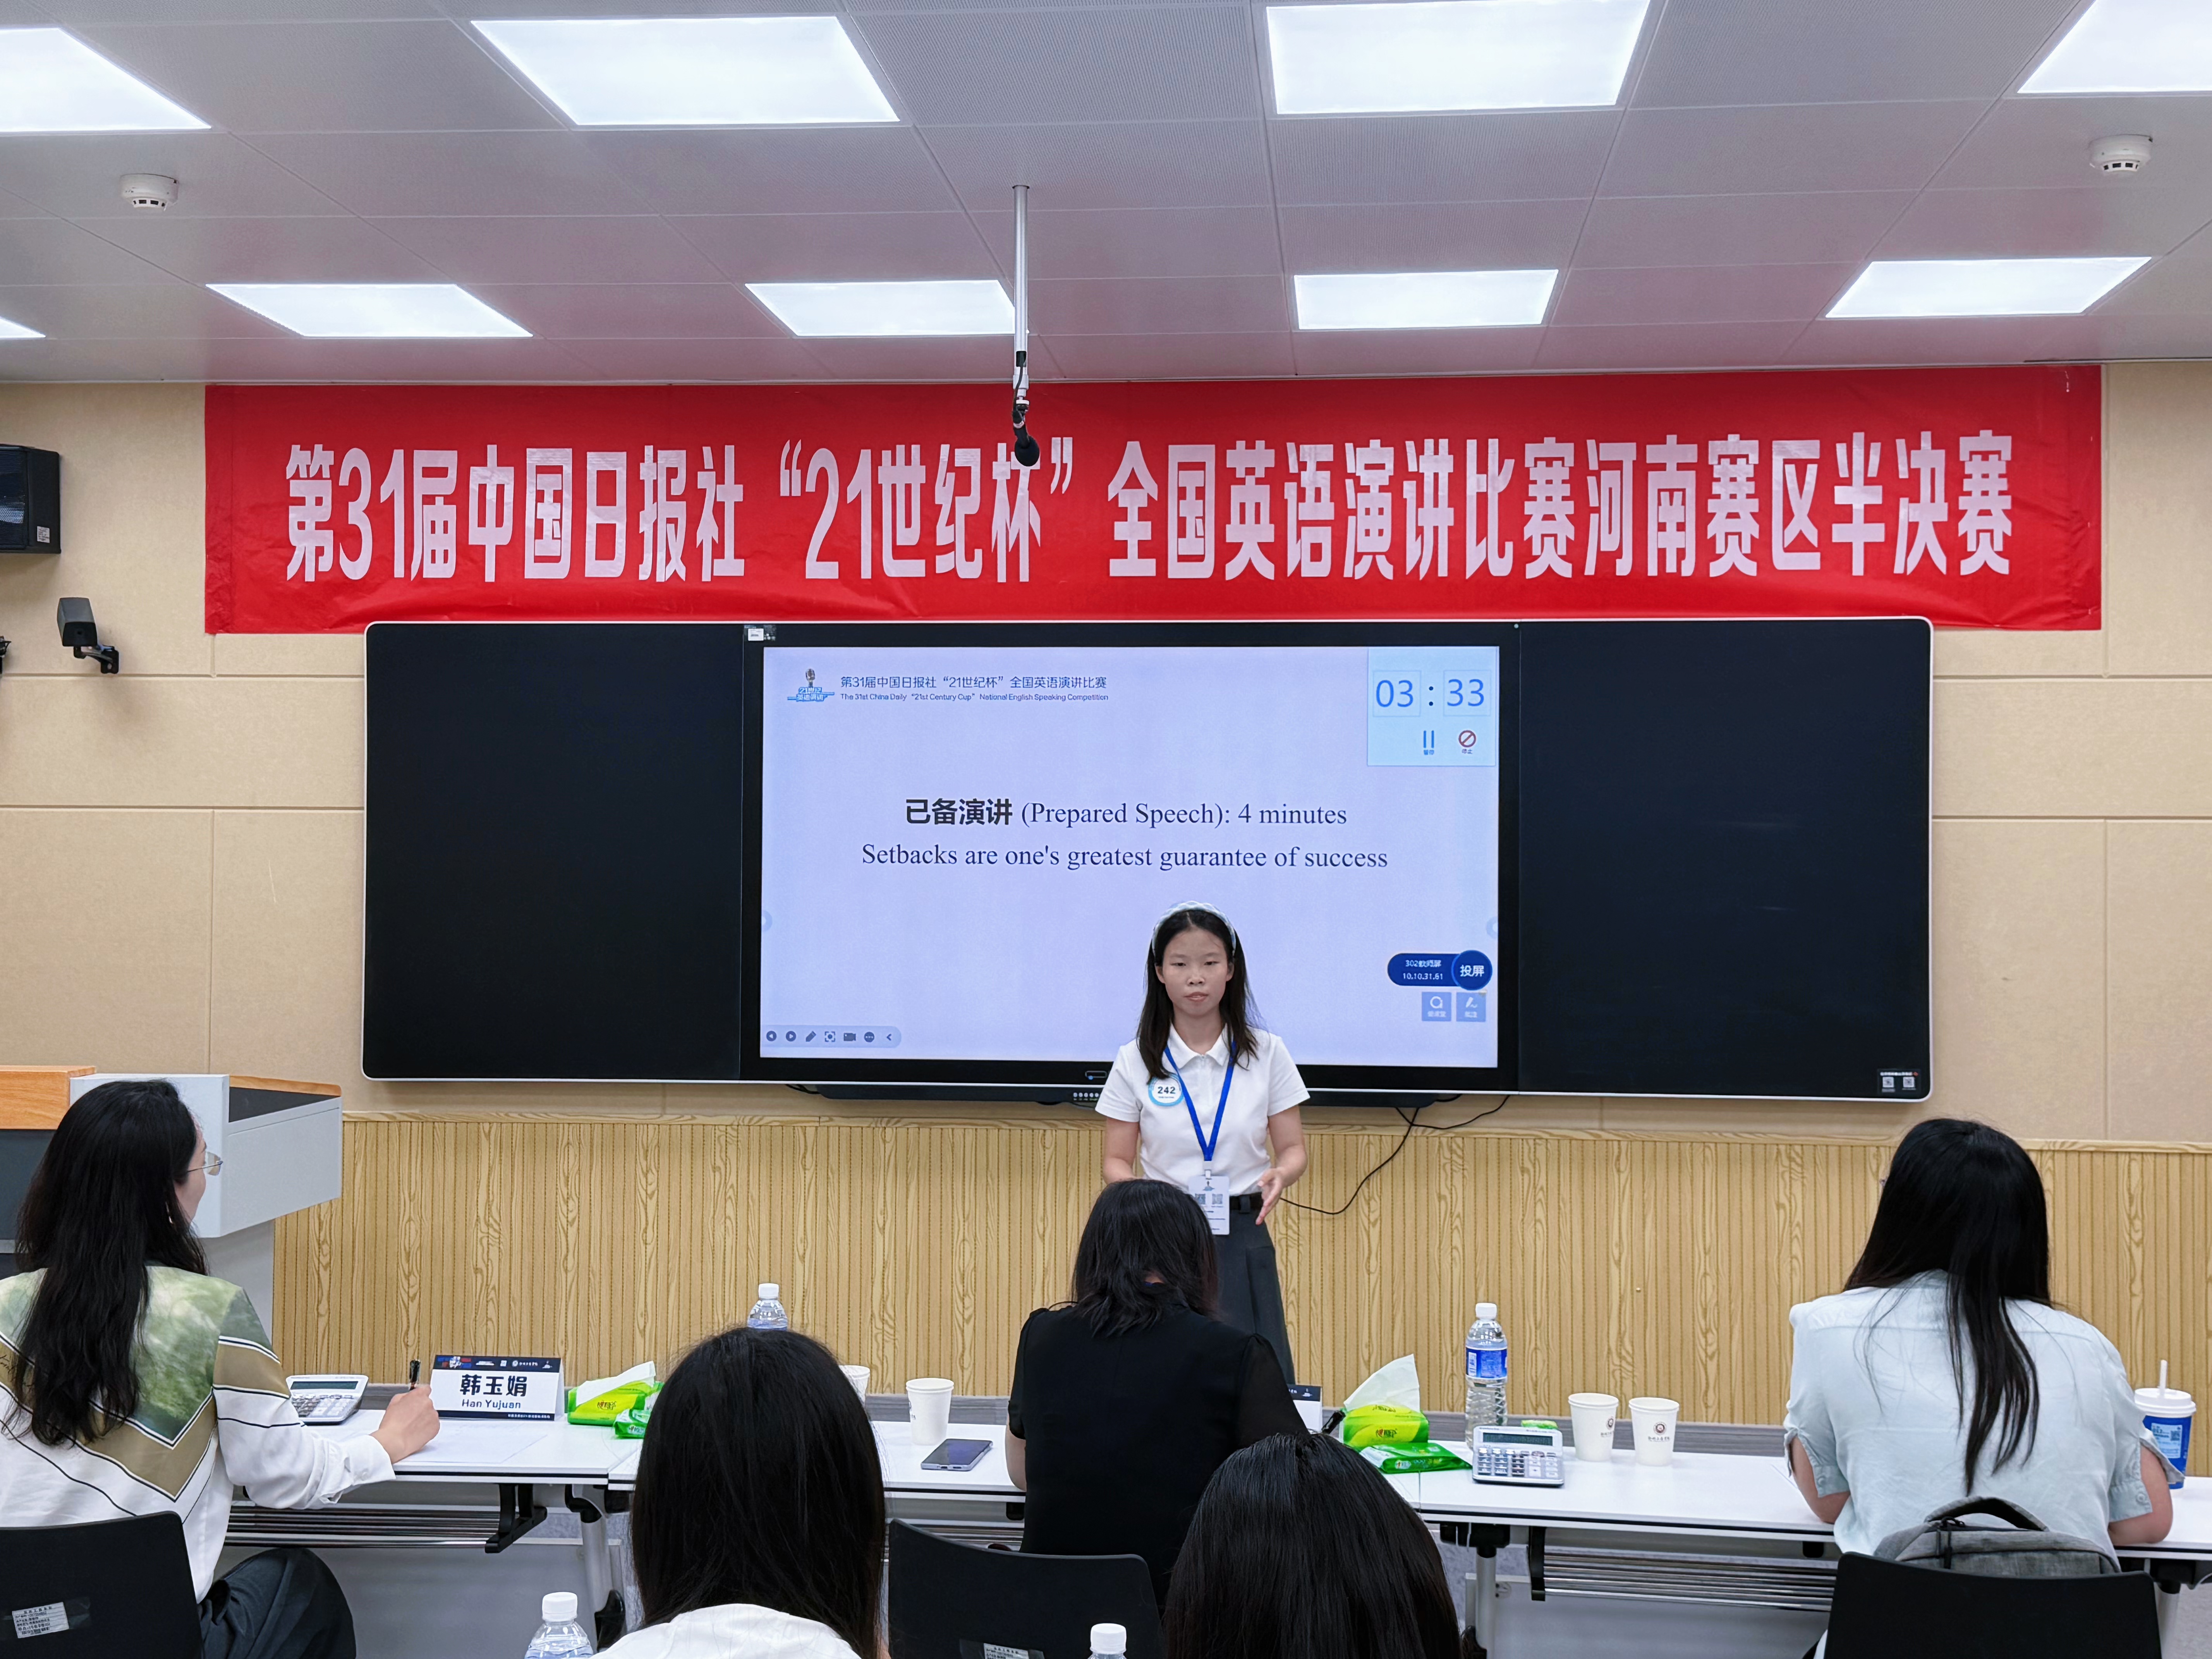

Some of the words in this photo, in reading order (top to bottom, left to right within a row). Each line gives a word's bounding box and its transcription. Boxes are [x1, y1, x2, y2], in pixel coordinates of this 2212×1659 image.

[1009, 694, 1033, 702] English
[1034, 694, 1066, 702] Speaking
[1068, 694, 1108, 702] Competition
[906, 798, 1013, 825] 已备演讲
[1022, 802, 1127, 828] (Prepared
[1136, 803, 1230, 829] Speech):
[1238, 804, 1252, 823] 4
[1259, 804, 1347, 824] minutes
[862, 844, 957, 864] Setbacks
[965, 851, 998, 864] are
[1005, 845, 1060, 865] one's
[1067, 848, 1152, 871] greatest
[1160, 849, 1266, 871] guarantee
[1274, 847, 1300, 867] of
[1305, 852, 1388, 867] success
[1460, 965, 1485, 977] 投屏
[460, 1374, 527, 1397] 韩玉娟
[462, 1399, 482, 1408] Han
[485, 1400, 521, 1410] Yujuan
